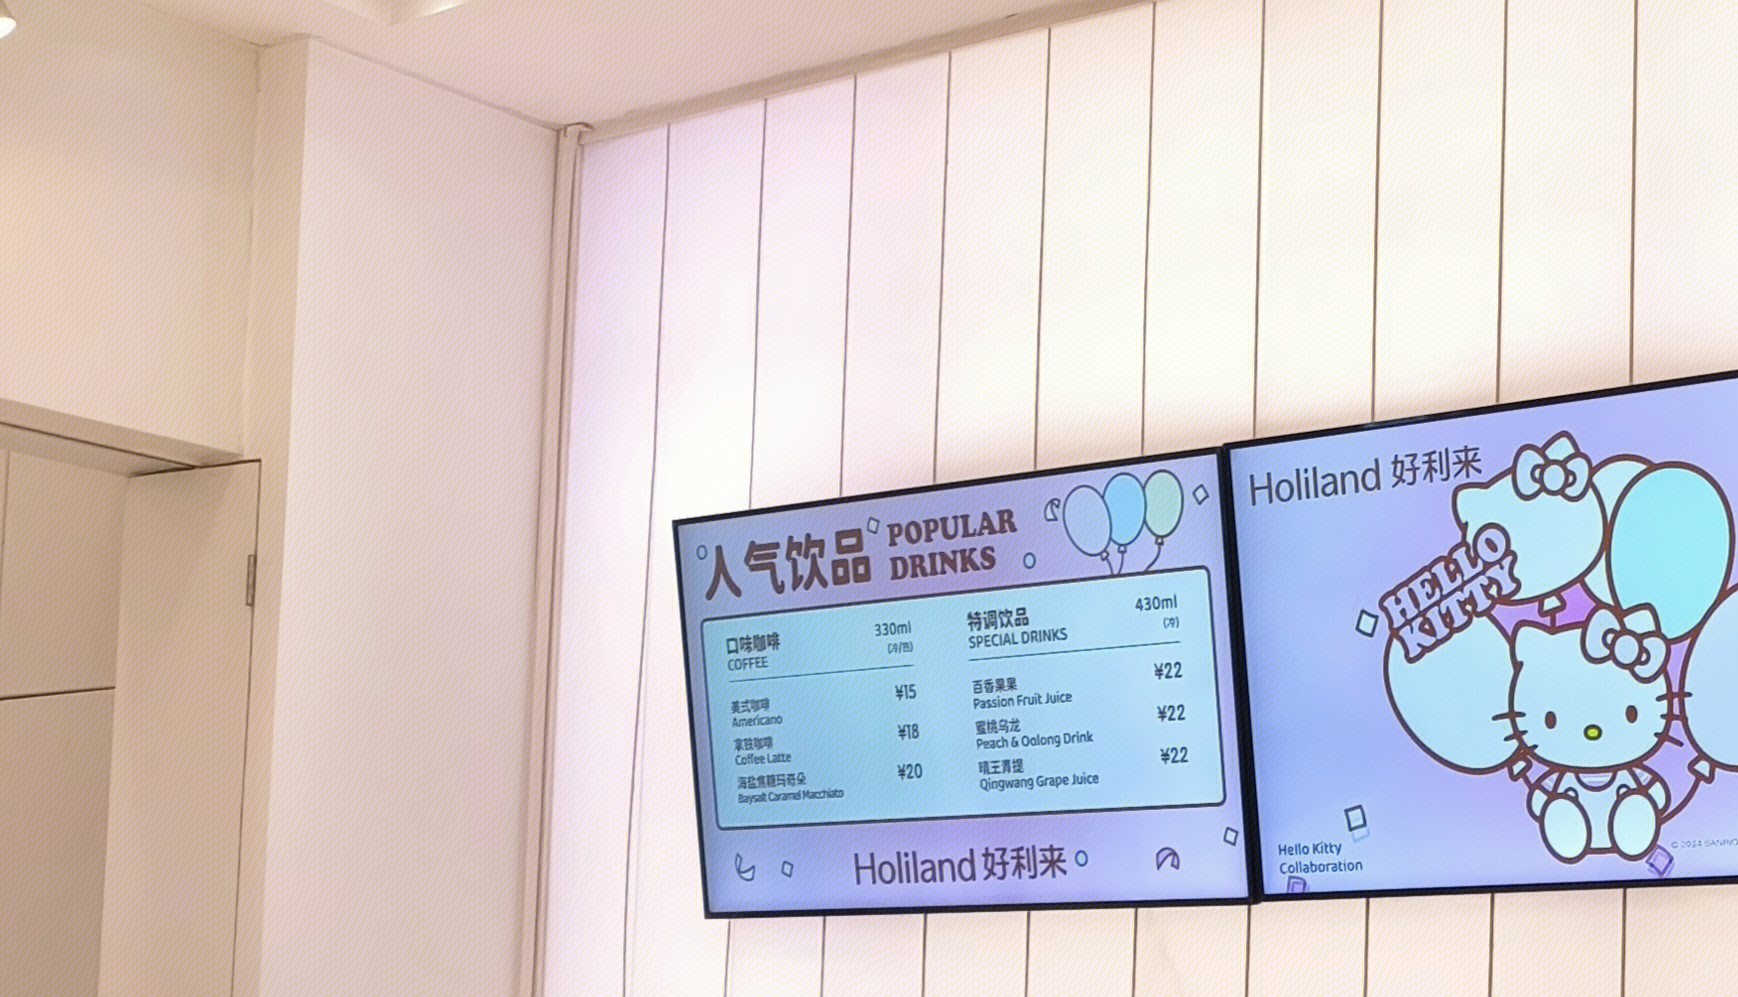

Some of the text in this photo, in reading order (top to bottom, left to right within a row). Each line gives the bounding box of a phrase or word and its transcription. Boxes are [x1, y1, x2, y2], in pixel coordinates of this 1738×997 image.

[1249, 445, 1482, 506] Holiland 好利来
[887, 508, 1017, 547] POPULAR
[705, 528, 872, 601] 人气饮品
[889, 546, 996, 580] DRINKS
[1381, 523, 1511, 630] HELLO
[1135, 594, 1178, 612] 430ml
[1399, 553, 1519, 661] KITTY
[874, 620, 912, 637] 330ml
[966, 607, 1030, 632] 特调饮品
[968, 627, 1069, 650] SPECIAL DRINKS
[727, 656, 769, 672] COFFEE
[1154, 662, 1183, 680] ¥22
[895, 684, 917, 701] ¥15
[973, 691, 1073, 709] Passion Fruit Juice
[732, 714, 783, 728] Americano
[1157, 704, 1186, 722] ¥22
[897, 723, 920, 741] ¥18
[975, 718, 1021, 735] 蜜桃乌龙
[976, 737, 1009, 750] Peach
[1011, 736, 1019, 748] &
[1063, 730, 1094, 745] Drink
[735, 752, 792, 766] Coffee Latte
[1160, 746, 1189, 765] ¥22
[897, 762, 923, 781] ¥20
[979, 772, 1100, 792] Qingwang Grape Juice
[1278, 841, 1342, 856] Hello Kitty
[854, 844, 1067, 885] Holiland 好利来
[1279, 859, 1363, 874] Collaboration
